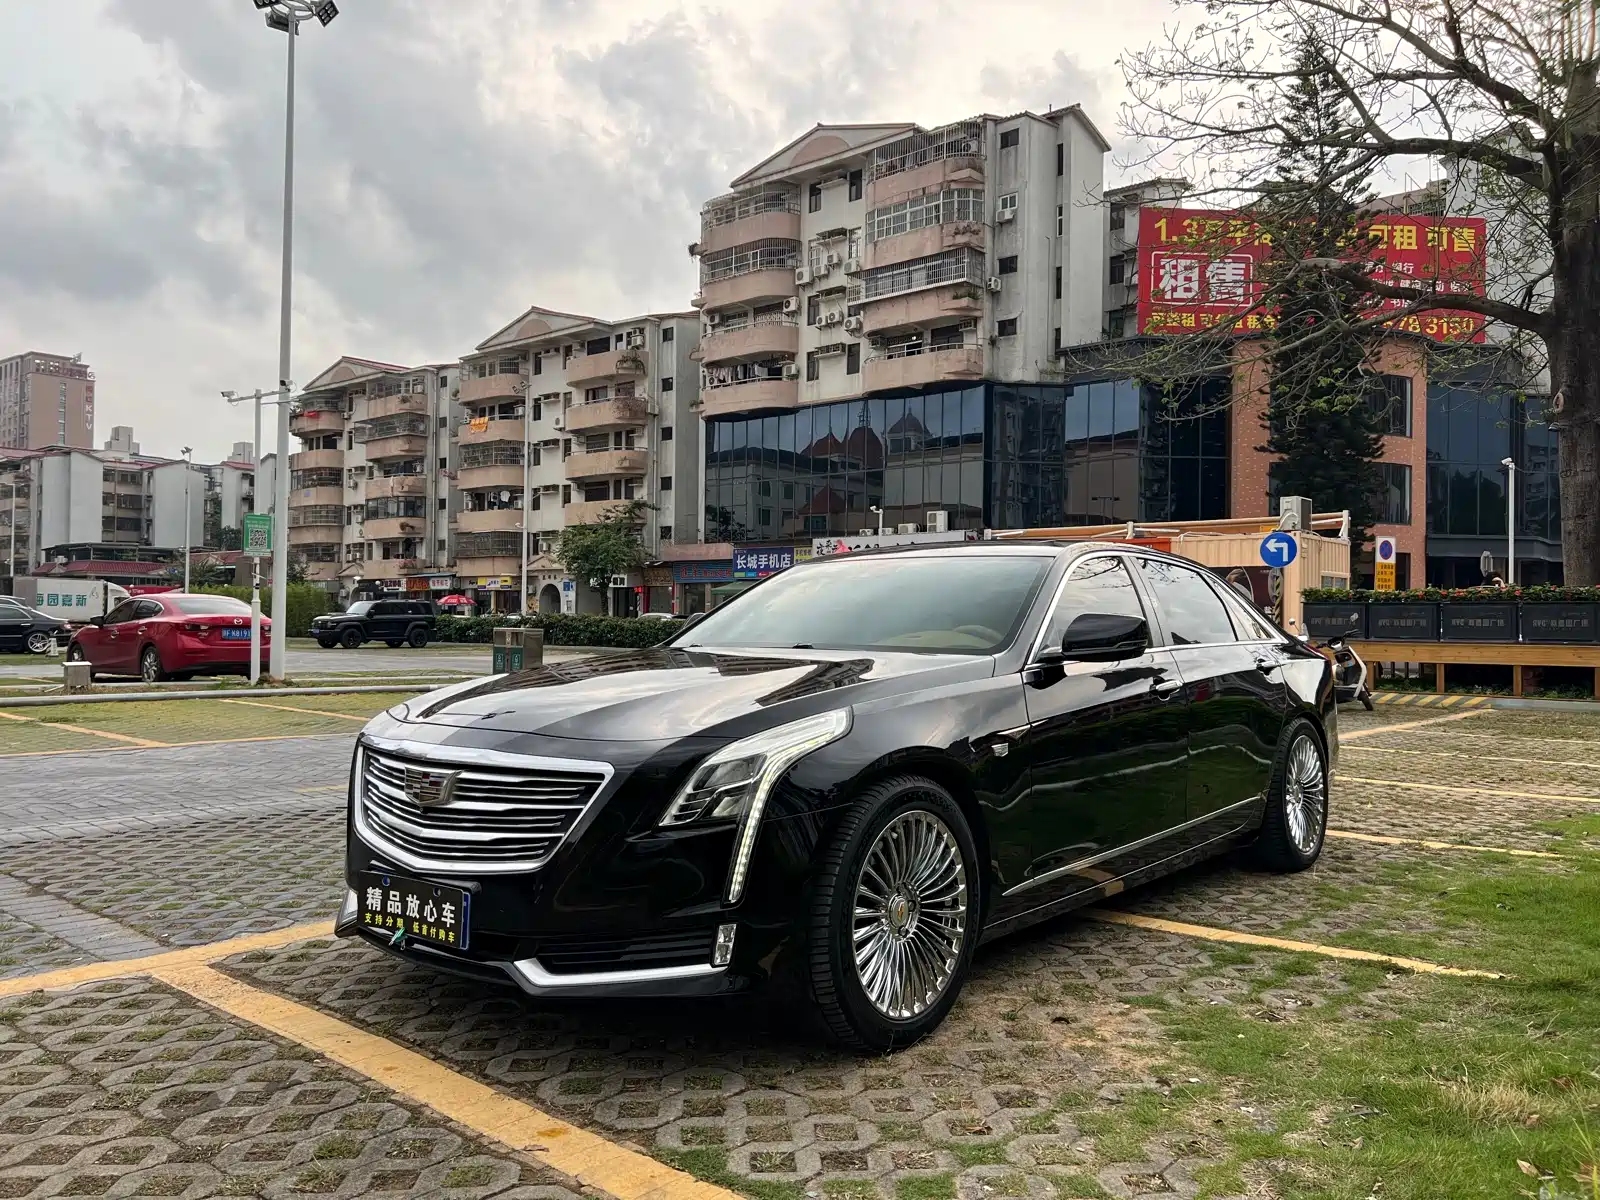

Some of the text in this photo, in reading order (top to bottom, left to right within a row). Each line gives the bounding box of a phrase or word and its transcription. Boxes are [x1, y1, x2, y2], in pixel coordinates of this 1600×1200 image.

[1158, 257, 1247, 304] 租售
[736, 552, 792, 570] 长城手机店
[366, 886, 456, 928] 精品放心车
[364, 911, 455, 943] 支持分期 低首付购车
